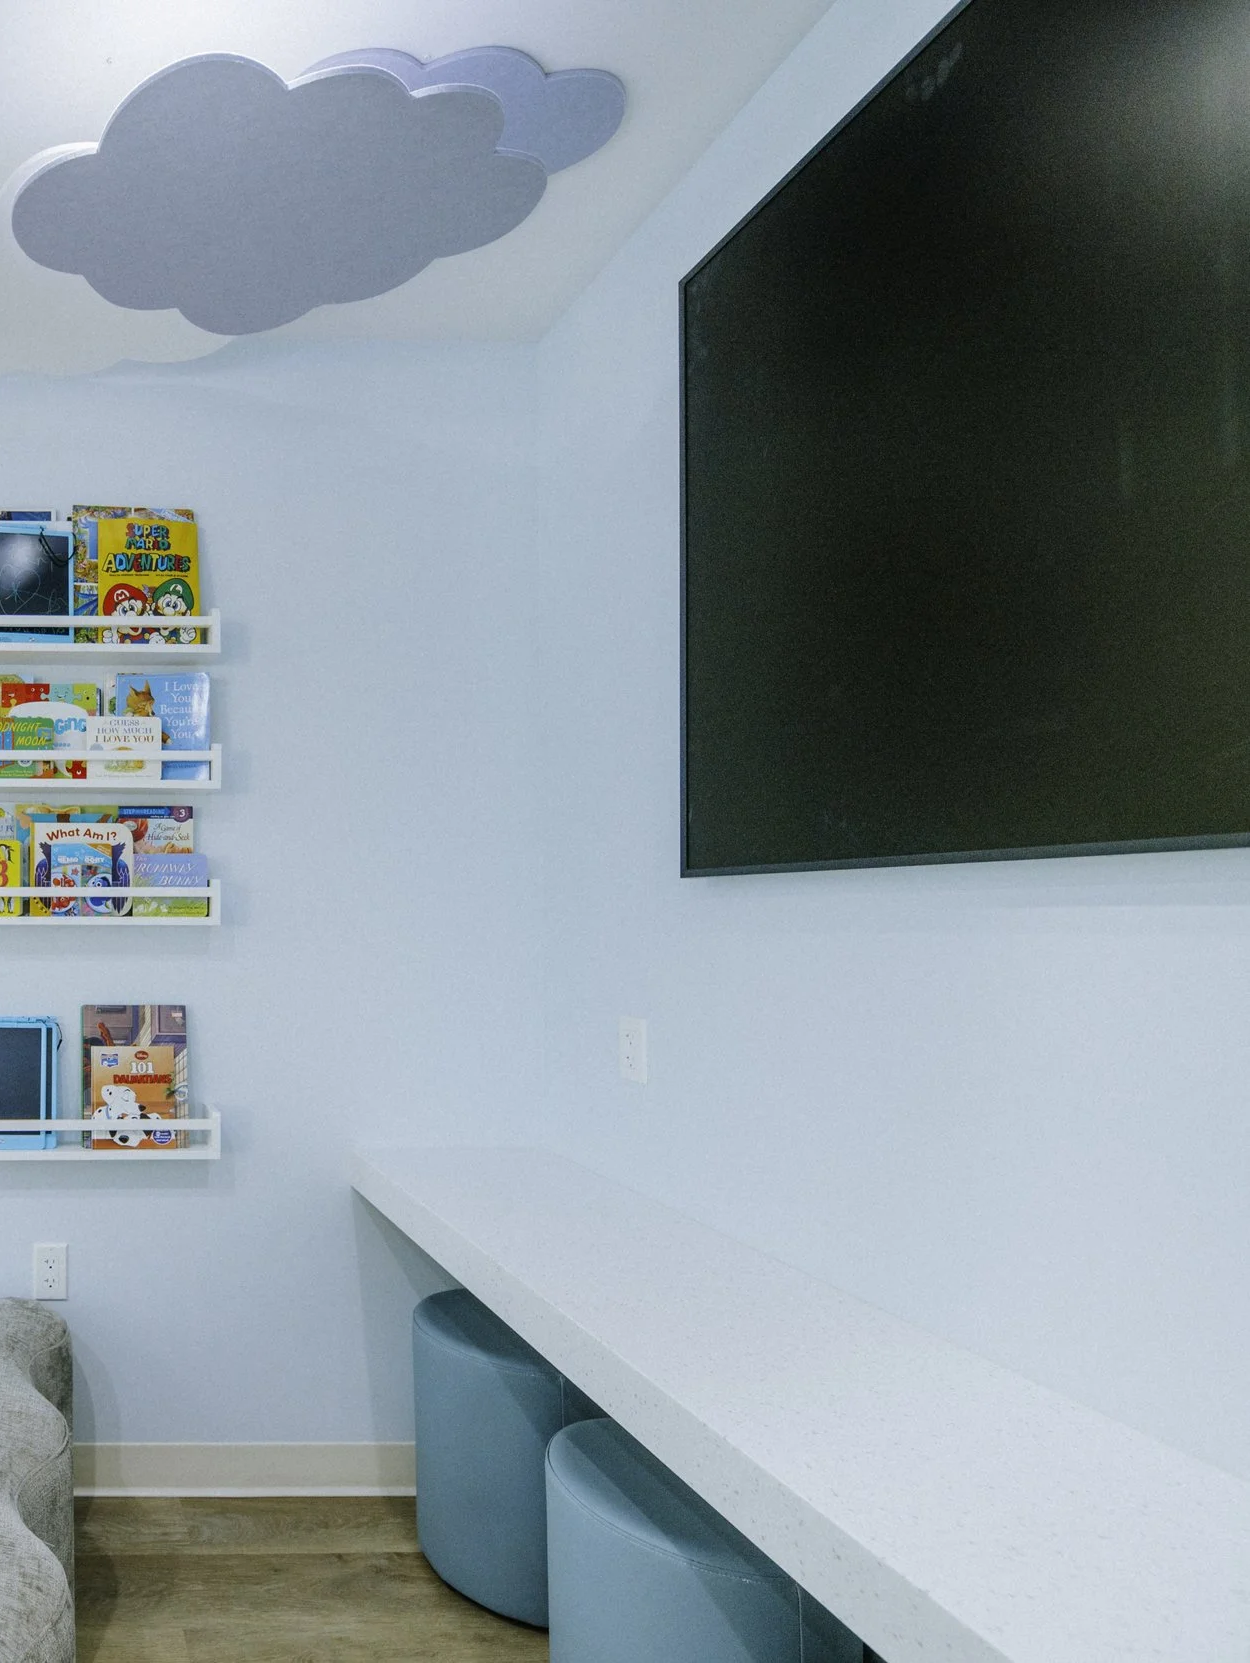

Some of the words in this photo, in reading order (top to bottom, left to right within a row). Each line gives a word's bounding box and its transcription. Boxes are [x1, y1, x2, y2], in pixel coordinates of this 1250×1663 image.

[126, 523, 169, 538] SUPER
[125, 537, 171, 551] MARIO
[102, 553, 191, 572] ADVENTURES
[160, 704, 193, 715] Becau
[15, 736, 48, 746] MOON
[103, 735, 131, 743] LOVE
[133, 735, 155, 743] YOU
[178, 808, 186, 818] 3
[46, 828, 80, 842] What
[83, 828, 104, 841] Am
[106, 831, 117, 842] I?
[130, 1061, 155, 1074] 101
